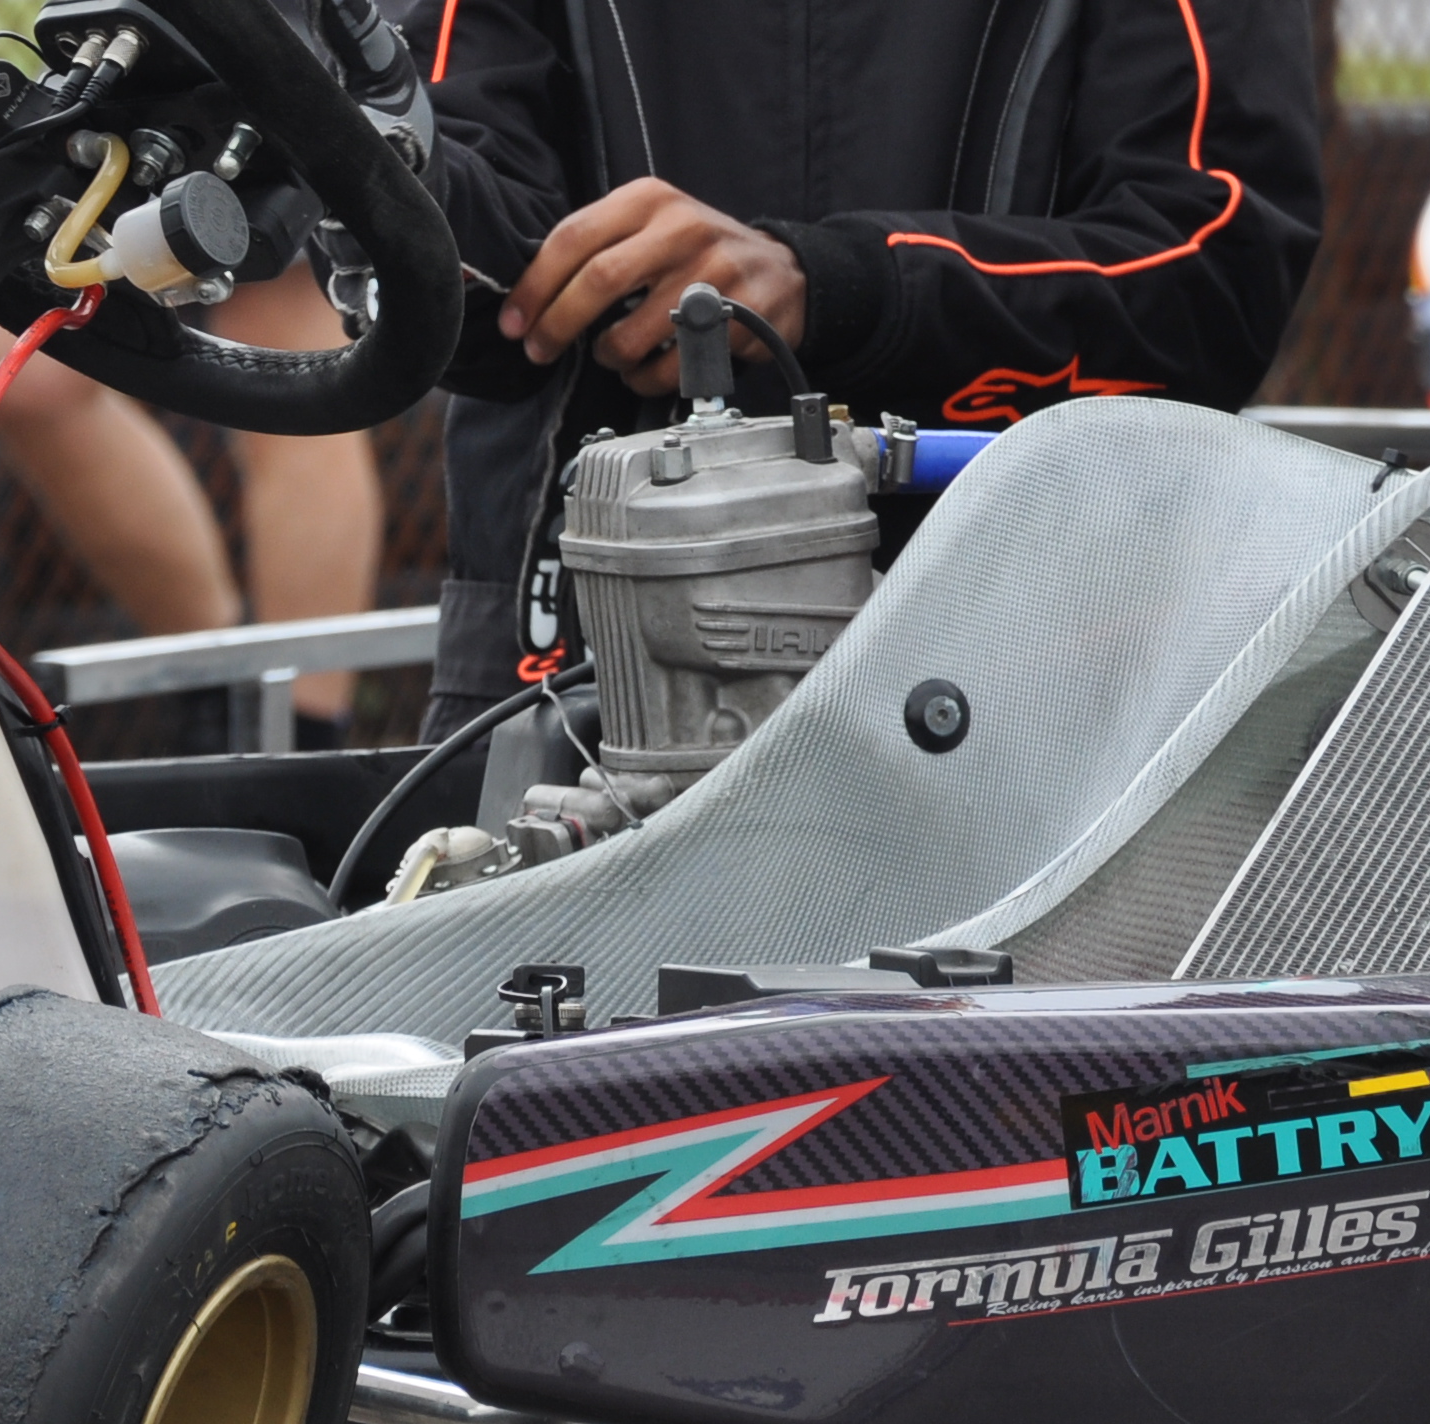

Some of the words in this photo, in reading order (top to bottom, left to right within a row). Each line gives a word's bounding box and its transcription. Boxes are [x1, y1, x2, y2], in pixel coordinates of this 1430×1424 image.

[1085, 1076, 1247, 1155] Marnik
[1189, 1189, 1430, 1274] Gilles
[813, 1231, 1174, 1324] Formula
[986, 1296, 1063, 1318] Racing
[1070, 1287, 1126, 1307] karts
[1133, 1272, 1219, 1298] inspired
[1225, 1268, 1250, 1285] by
[1254, 1258, 1335, 1283] passion
[1340, 1248, 1382, 1267] and
